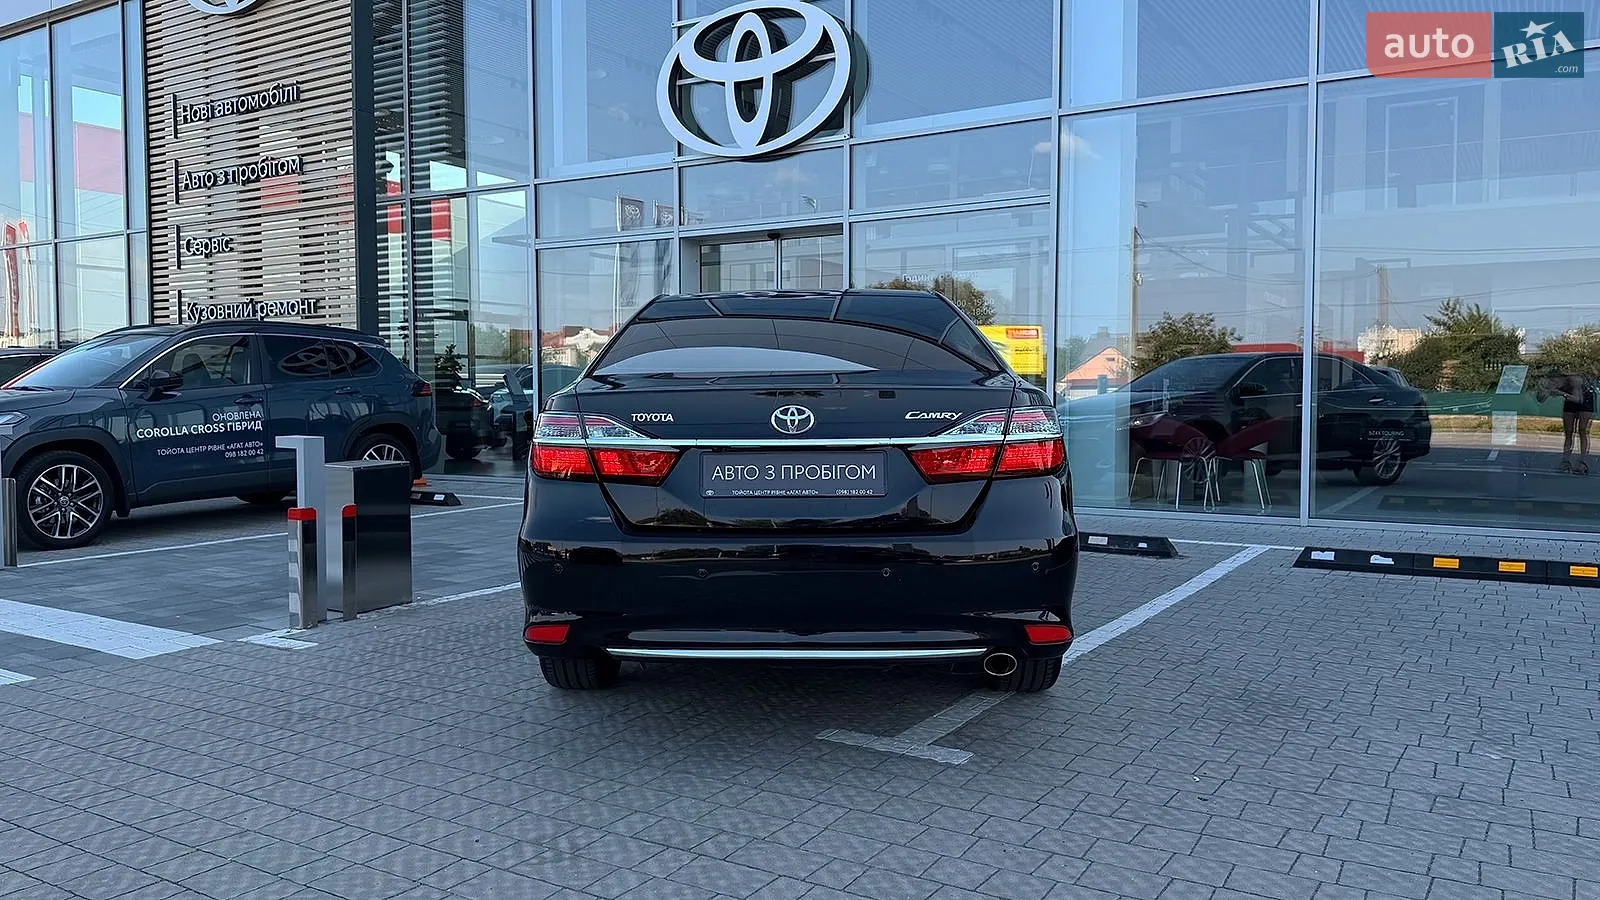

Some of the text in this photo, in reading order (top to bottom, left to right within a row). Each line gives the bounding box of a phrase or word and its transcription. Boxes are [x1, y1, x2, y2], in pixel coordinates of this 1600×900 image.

[181, 81, 299, 122] Нові автомобілі
[182, 156, 302, 190] Авто з пробігом
[184, 233, 232, 258] Сервіс
[185, 298, 316, 323] Кузовний ремонт
[212, 410, 263, 422] ОНОВЛЕНА
[631, 413, 674, 422] TOYOTA
[905, 411, 963, 420] CAMRY
[136, 420, 263, 438] COROLLA CROSS ГІБРИД
[157, 448, 185, 456] ТОЙОТА
[186, 446, 207, 454] ЦЕНТР
[208, 444, 226, 452] РІВНЕ
[711, 464, 876, 481] АВТО З ПРОБІГОМ
